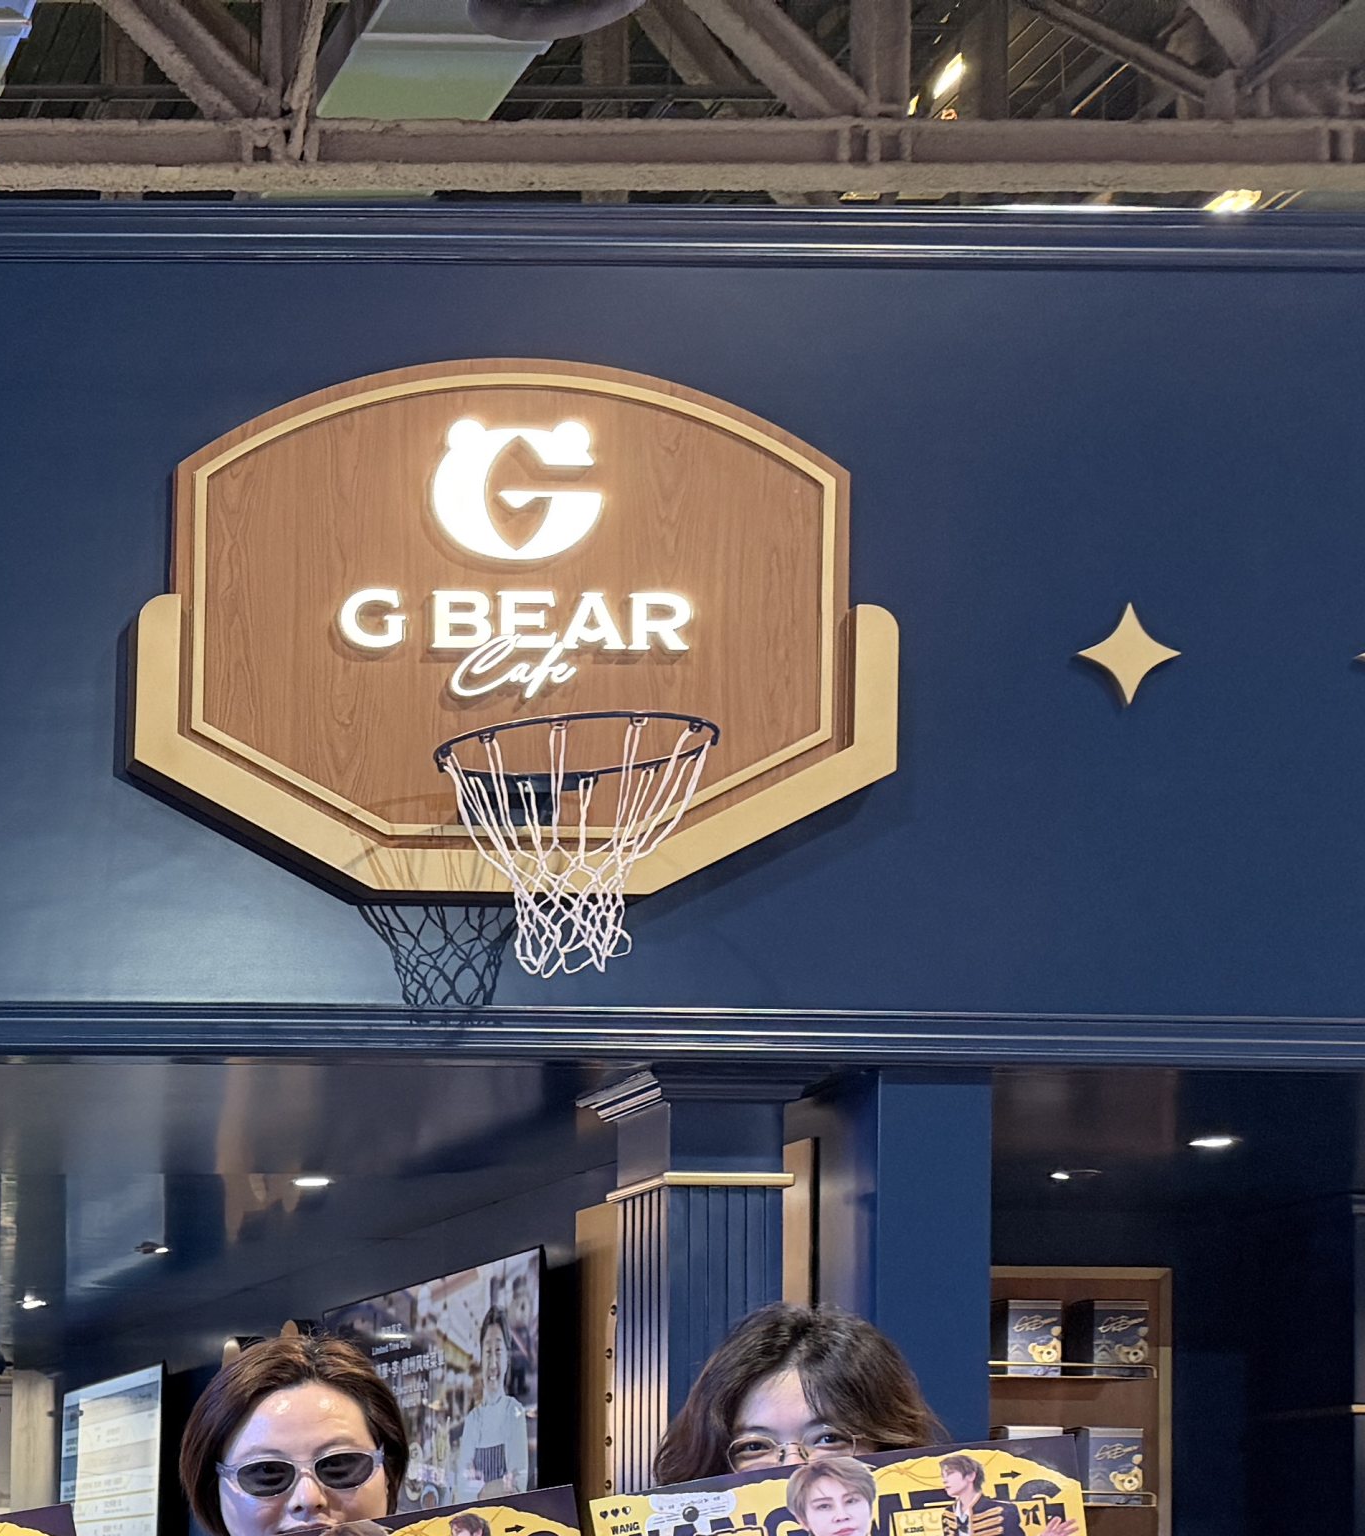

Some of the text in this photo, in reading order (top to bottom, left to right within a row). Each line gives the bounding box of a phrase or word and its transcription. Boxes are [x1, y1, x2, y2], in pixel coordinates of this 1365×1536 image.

[340, 588, 693, 651] G BEAR
[610, 1521, 641, 1534] WANG
